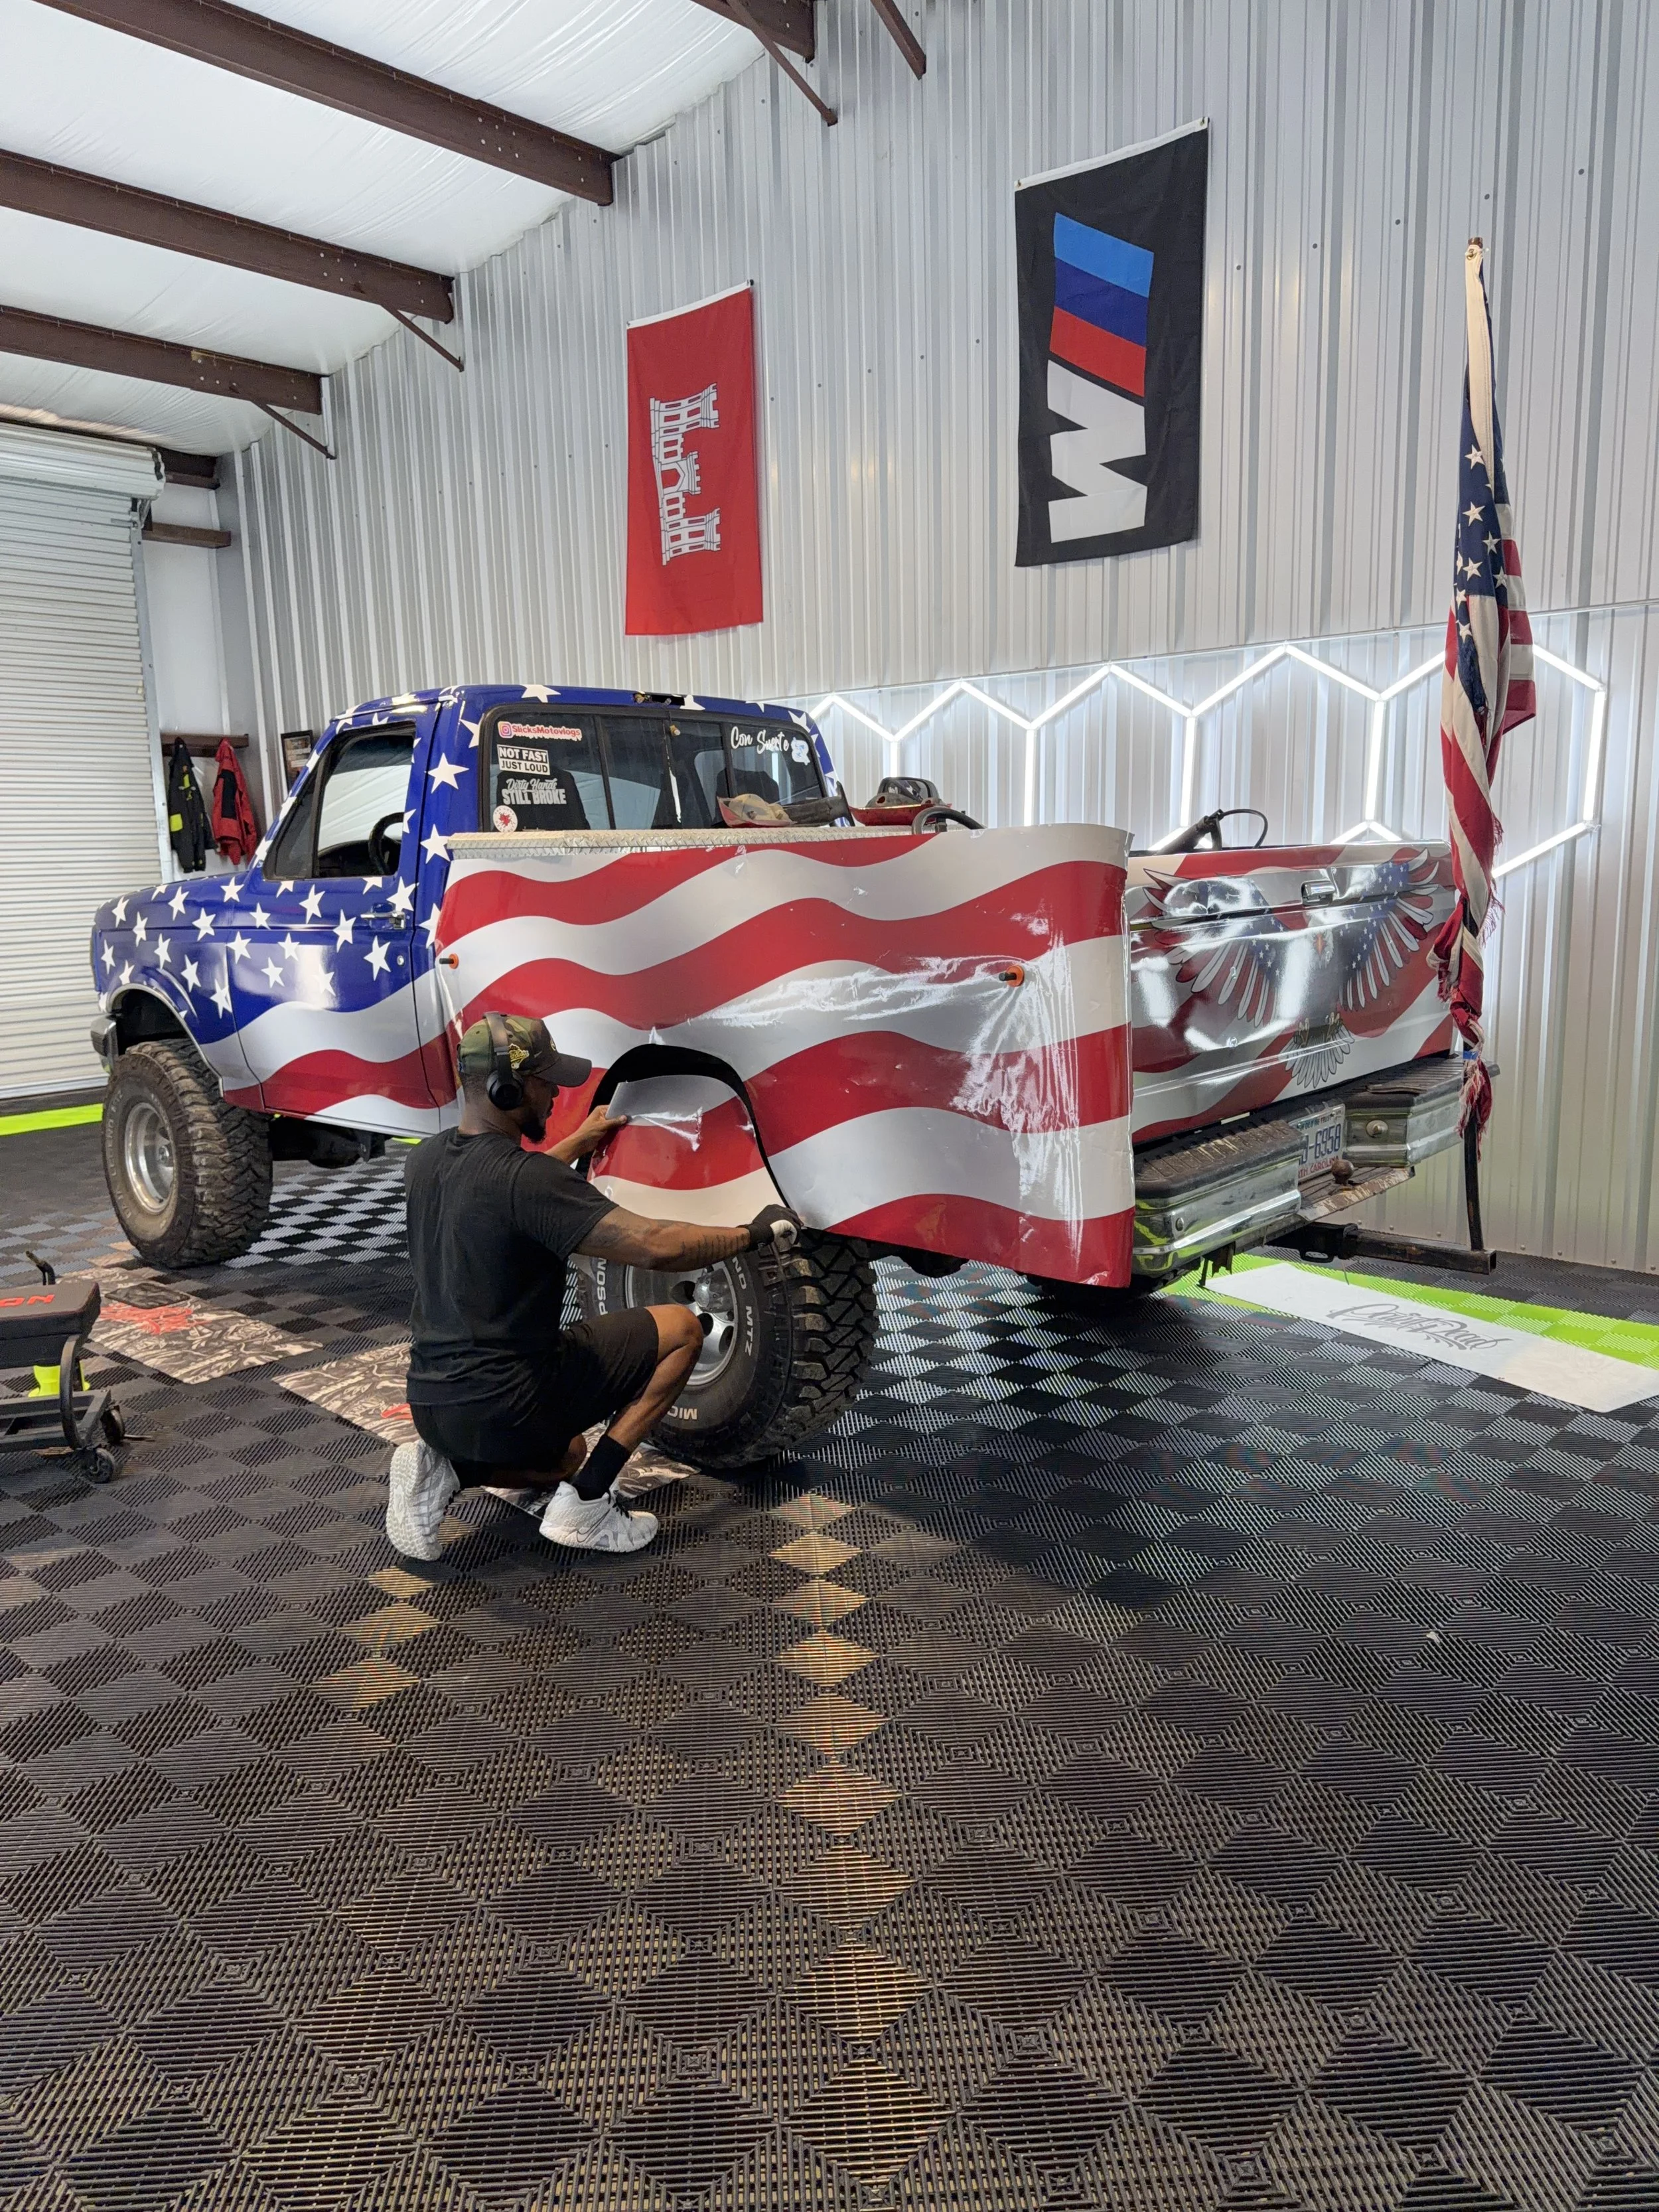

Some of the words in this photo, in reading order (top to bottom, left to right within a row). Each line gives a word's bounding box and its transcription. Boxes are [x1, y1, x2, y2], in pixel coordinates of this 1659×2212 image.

[512, 725, 581, 737] SlicksMotovlogs
[731, 725, 753, 749] Con
[757, 729, 790, 755] Suerte
[498, 747, 520, 759] NOT
[522, 749, 547, 763] FAST
[501, 760, 522, 770] JUST
[524, 763, 548, 773] LOUD
[506, 778, 529, 791] Dirty
[530, 778, 558, 790] Hands
[502, 788, 532, 805] STILL
[532, 788, 567, 804] BROKE
[597, 1257, 609, 1315] PSON
[745, 1305, 753, 1357] MTZ
[667, 1405, 697, 1420] MIC
